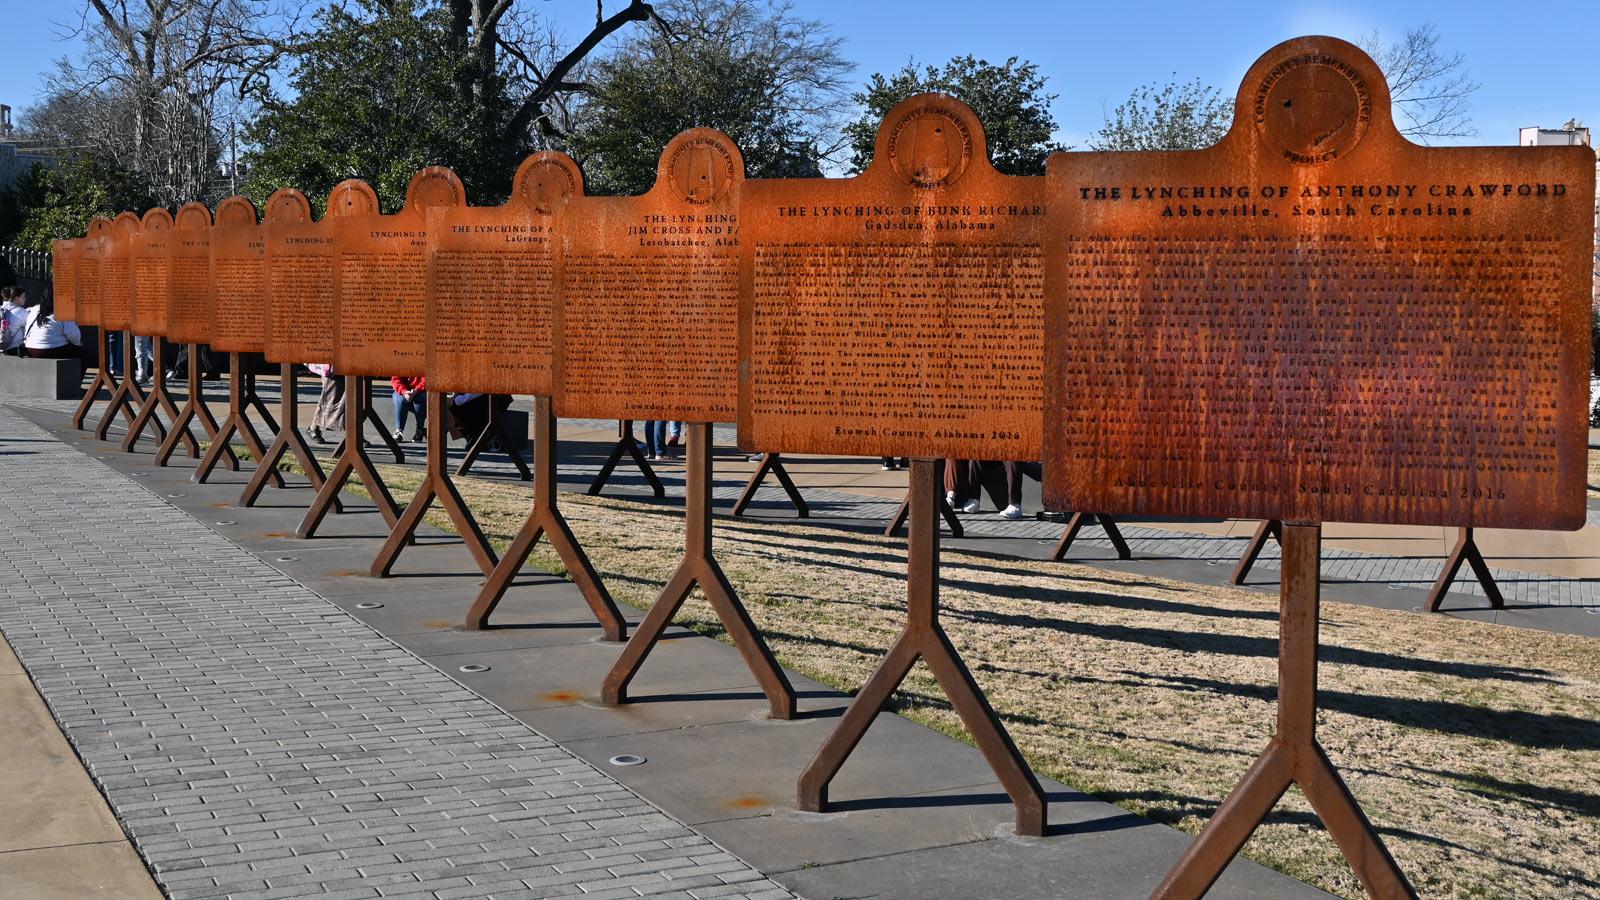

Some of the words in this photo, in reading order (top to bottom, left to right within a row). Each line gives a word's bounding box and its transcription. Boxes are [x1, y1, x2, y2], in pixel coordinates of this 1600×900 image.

[1255, 57, 1300, 124] COMMUNITY
[889, 109, 921, 158] COMMUNITY
[1284, 149, 1338, 164] PROJECT
[911, 177, 949, 189] PROJECT
[1080, 187, 1121, 200] THE
[1131, 187, 1250, 199] LYNCHING
[1261, 187, 1289, 198] OF
[1301, 186, 1417, 198] ANTHONY
[1429, 184, 1567, 197] CRAWFORD
[778, 206, 807, 216] THE
[812, 205, 895, 216] LYNCHING
[901, 205, 921, 216] OF
[927, 205, 971, 216] BUNK
[1161, 205, 1280, 218] Abbeville,
[1292, 204, 1355, 217] South
[1370, 204, 1471, 217] Carolina
[644, 215, 667, 223] THE
[672, 215, 737, 223] LYNCHING
[452, 225, 471, 233] THE
[474, 225, 526, 233] LYNCHING
[529, 225, 543, 233] OF
[628, 226, 647, 236] JIM
[652, 226, 691, 234] CROSS
[696, 226, 722, 234] AND
[864, 220, 927, 232] Gadsden,
[935, 220, 996, 231] Alabama
[505, 234, 551, 244] LaGrange,
[640, 238, 711, 247] Letohatchee,
[1089, 234, 1147, 242] Abbeville
[1156, 247, 1210, 256] Anthony
[1216, 247, 1276, 255] Crawford
[1096, 271, 1140, 280] helped
[1146, 271, 1206, 279] establish
[1152, 283, 1198, 293] During
[1234, 284, 1258, 292] Jim
[1181, 297, 1230, 306] arguing
[1238, 296, 1266, 304] with
[1272, 297, 1308, 305] white
[899, 302, 930, 311] County
[949, 302, 991, 311] following
[1068, 307, 1102, 315] white
[1173, 308, 1236, 316] demanded
[833, 311, 869, 319] Gardner,
[815, 320, 830, 328] The
[860, 321, 878, 329] Will
[1280, 321, 1300, 329] sell
[1306, 321, 1325, 329] his
[1330, 322, 1368, 332] family
[811, 331, 850, 339] Governor
[854, 331, 888, 339] William
[972, 333, 1015, 342] Johnson's
[1110, 332, 1145, 343] Penny
[1204, 333, 1250, 341] refused
[927, 351, 946, 359] Will
[1166, 345, 1198, 353] hours
[1244, 345, 1266, 354] 300
[1272, 346, 1306, 354] white
[1312, 347, 1336, 355] men
[1068, 355, 1088, 363] him
[1182, 357, 1225, 365] behind
[963, 362, 986, 370] Bunk
[860, 370, 880, 378] been
[1276, 371, 1302, 379] shot
[1359, 385, 1412, 395] hanging
[1419, 385, 1450, 395] body
[1496, 387, 1517, 395] the
[960, 392, 988, 400] forced
[625, 402, 665, 411] Lowndes
[912, 401, 936, 409] Black
[940, 402, 987, 411] community
[1416, 398, 1479, 408] Crawford
[1485, 400, 1527, 411] family
[1534, 400, 1557, 409] and
[775, 408, 807, 417] charged
[841, 410, 878, 419] lynching
[1344, 409, 1405, 418] Abbeville
[835, 426, 877, 436] Etowah
[882, 428, 929, 439] County,
[934, 429, 986, 440] Alabama
[991, 430, 1021, 440] 2016
[1477, 439, 1526, 447] wisdom
[1533, 440, 1556, 448] and
[1470, 451, 1556, 460] remembrance
[1477, 463, 1528, 472] October
[1114, 477, 1203, 490] Abbeville
[1298, 482, 1351, 495] South
[1363, 484, 1449, 498] Carolina
[1459, 487, 1506, 500] 2016
